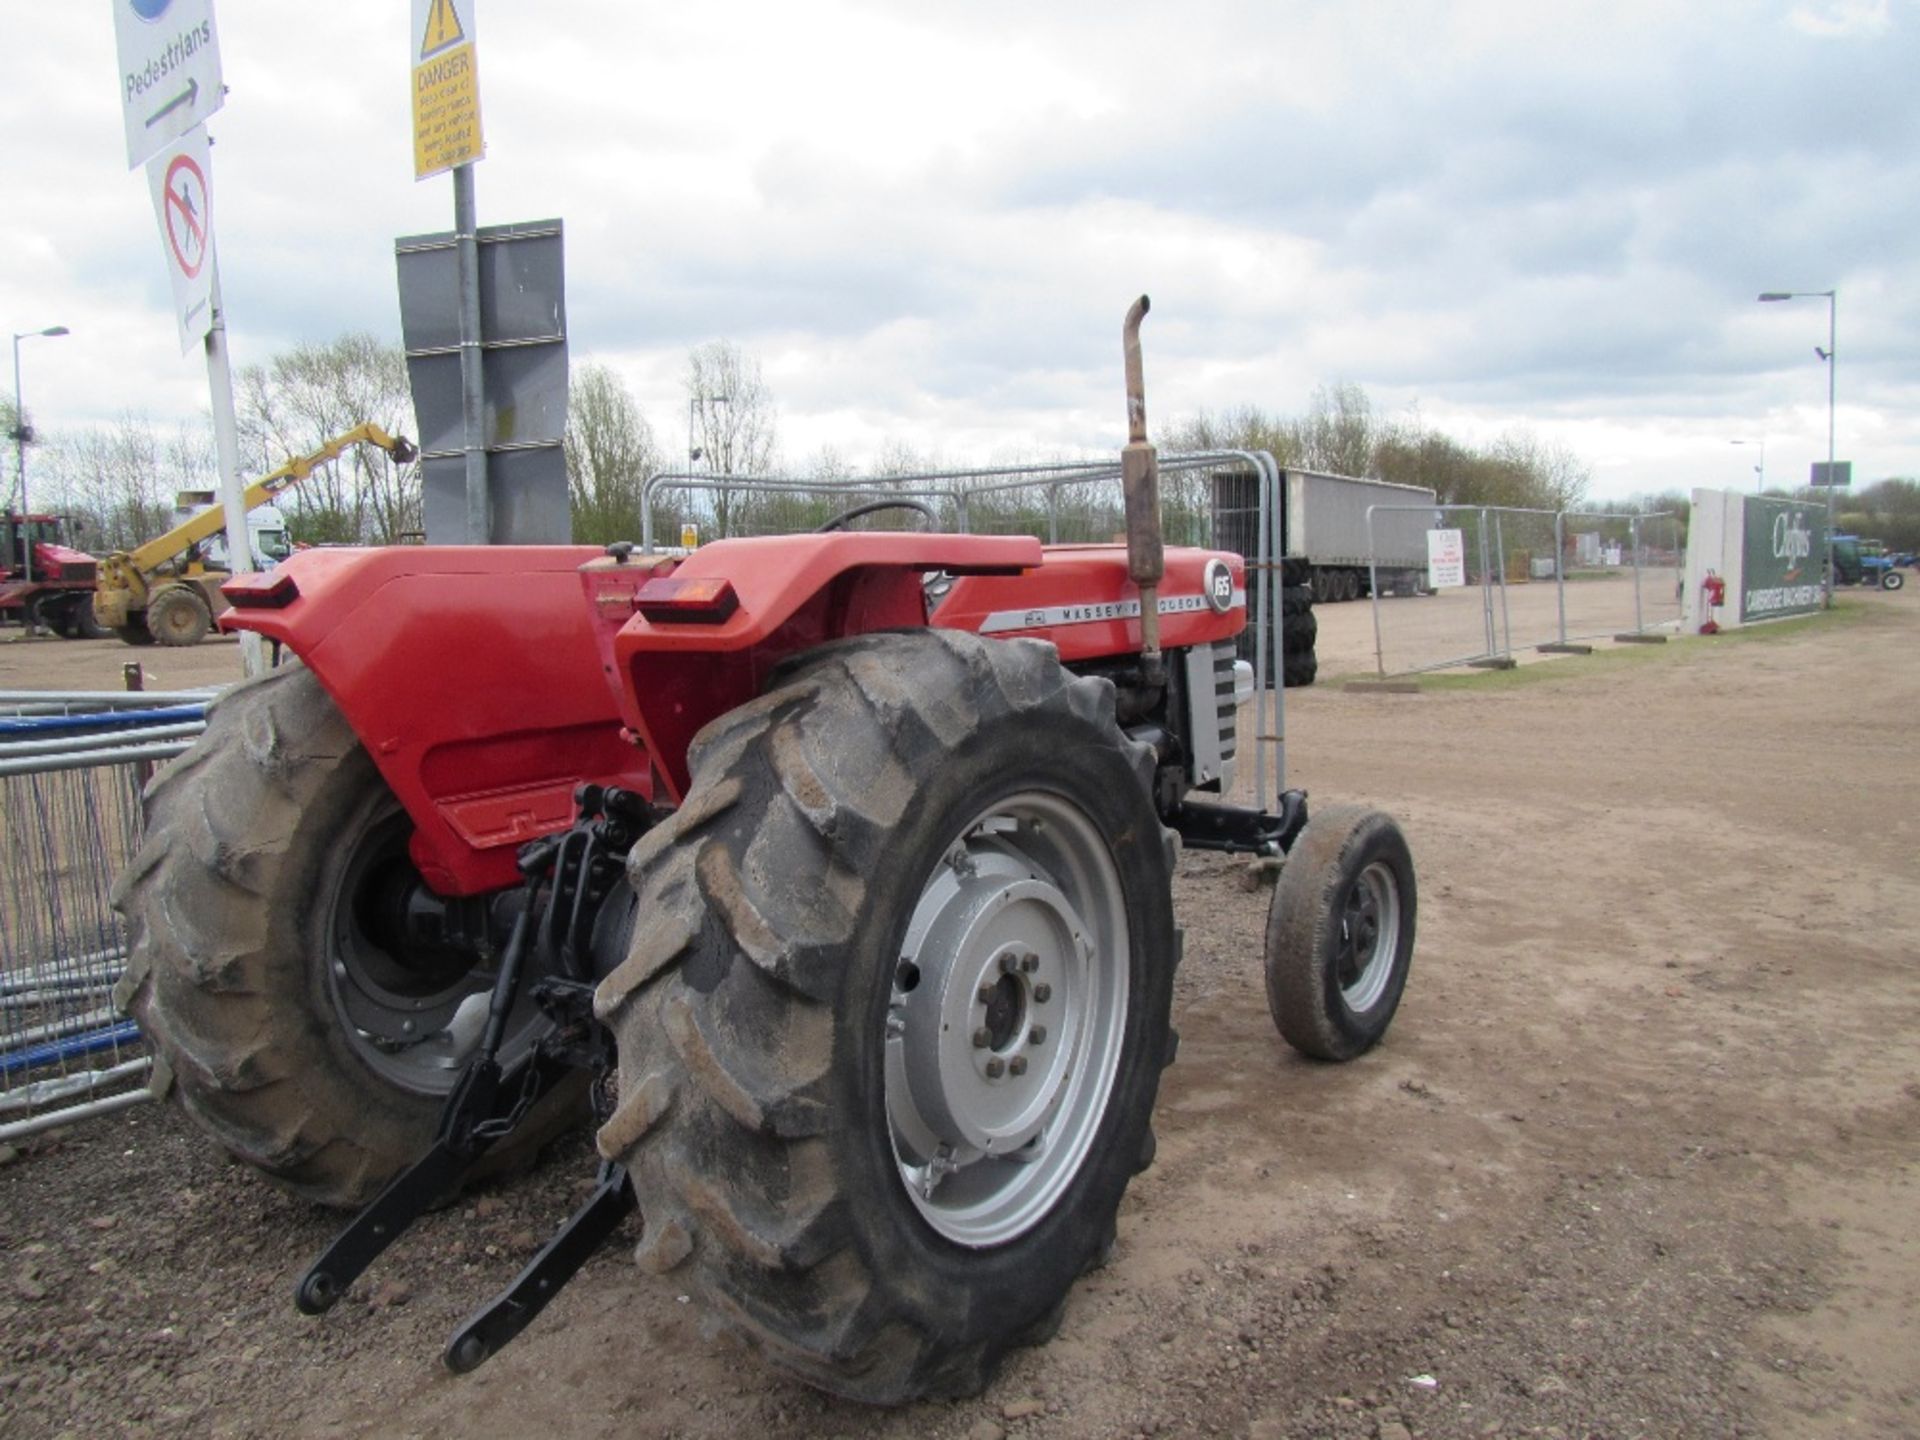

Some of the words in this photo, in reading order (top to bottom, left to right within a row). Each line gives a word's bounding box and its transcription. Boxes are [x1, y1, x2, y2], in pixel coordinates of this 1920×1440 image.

[127, 20, 210, 103] Pedestrians
[418, 52, 469, 92] DANGER
[1214, 576, 1229, 597] 165
